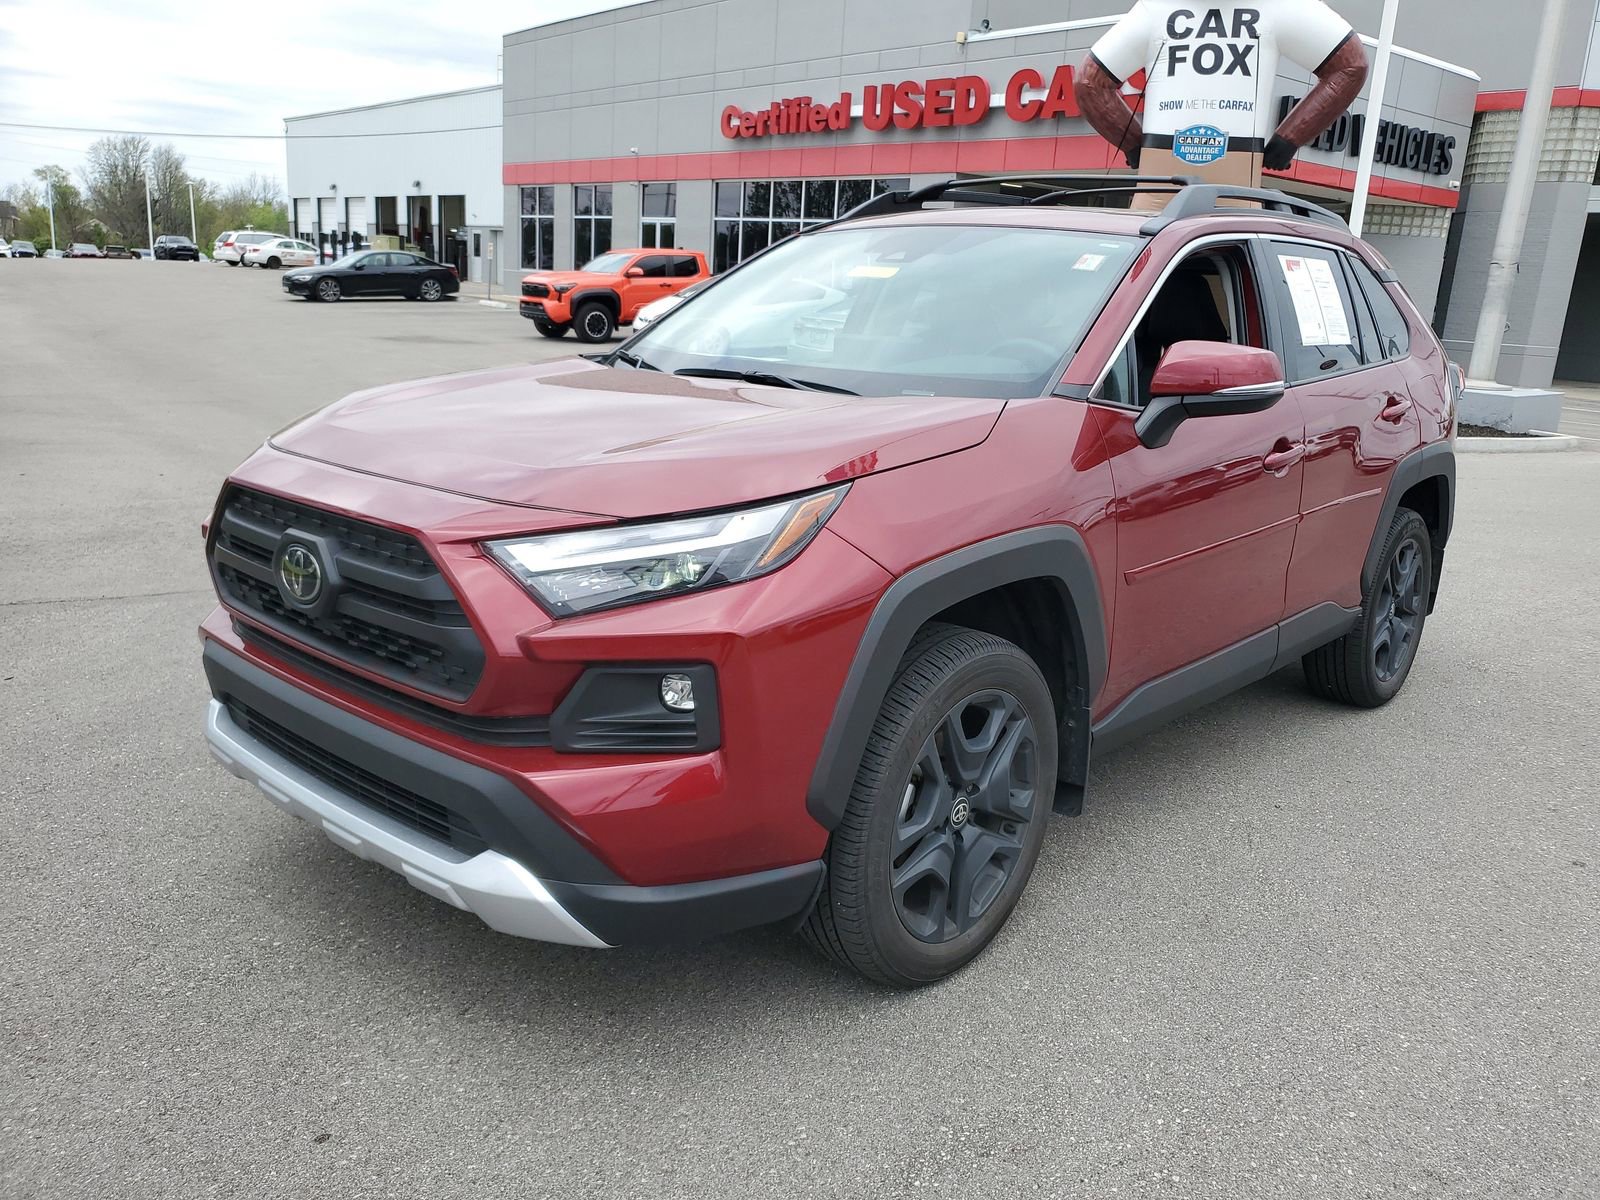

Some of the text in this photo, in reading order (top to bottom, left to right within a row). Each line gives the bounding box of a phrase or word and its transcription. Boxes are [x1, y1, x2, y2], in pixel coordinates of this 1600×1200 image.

[1166, 8, 1260, 39] CAR
[1166, 42, 1253, 77] FOX
[721, 91, 852, 139] Certified
[863, 74, 991, 131] USED
[1159, 99, 1254, 112] SHOW ME THE CARFAX
[1178, 136, 1223, 146] CARFAX
[1180, 146, 1219, 155] ADVANTAGE
